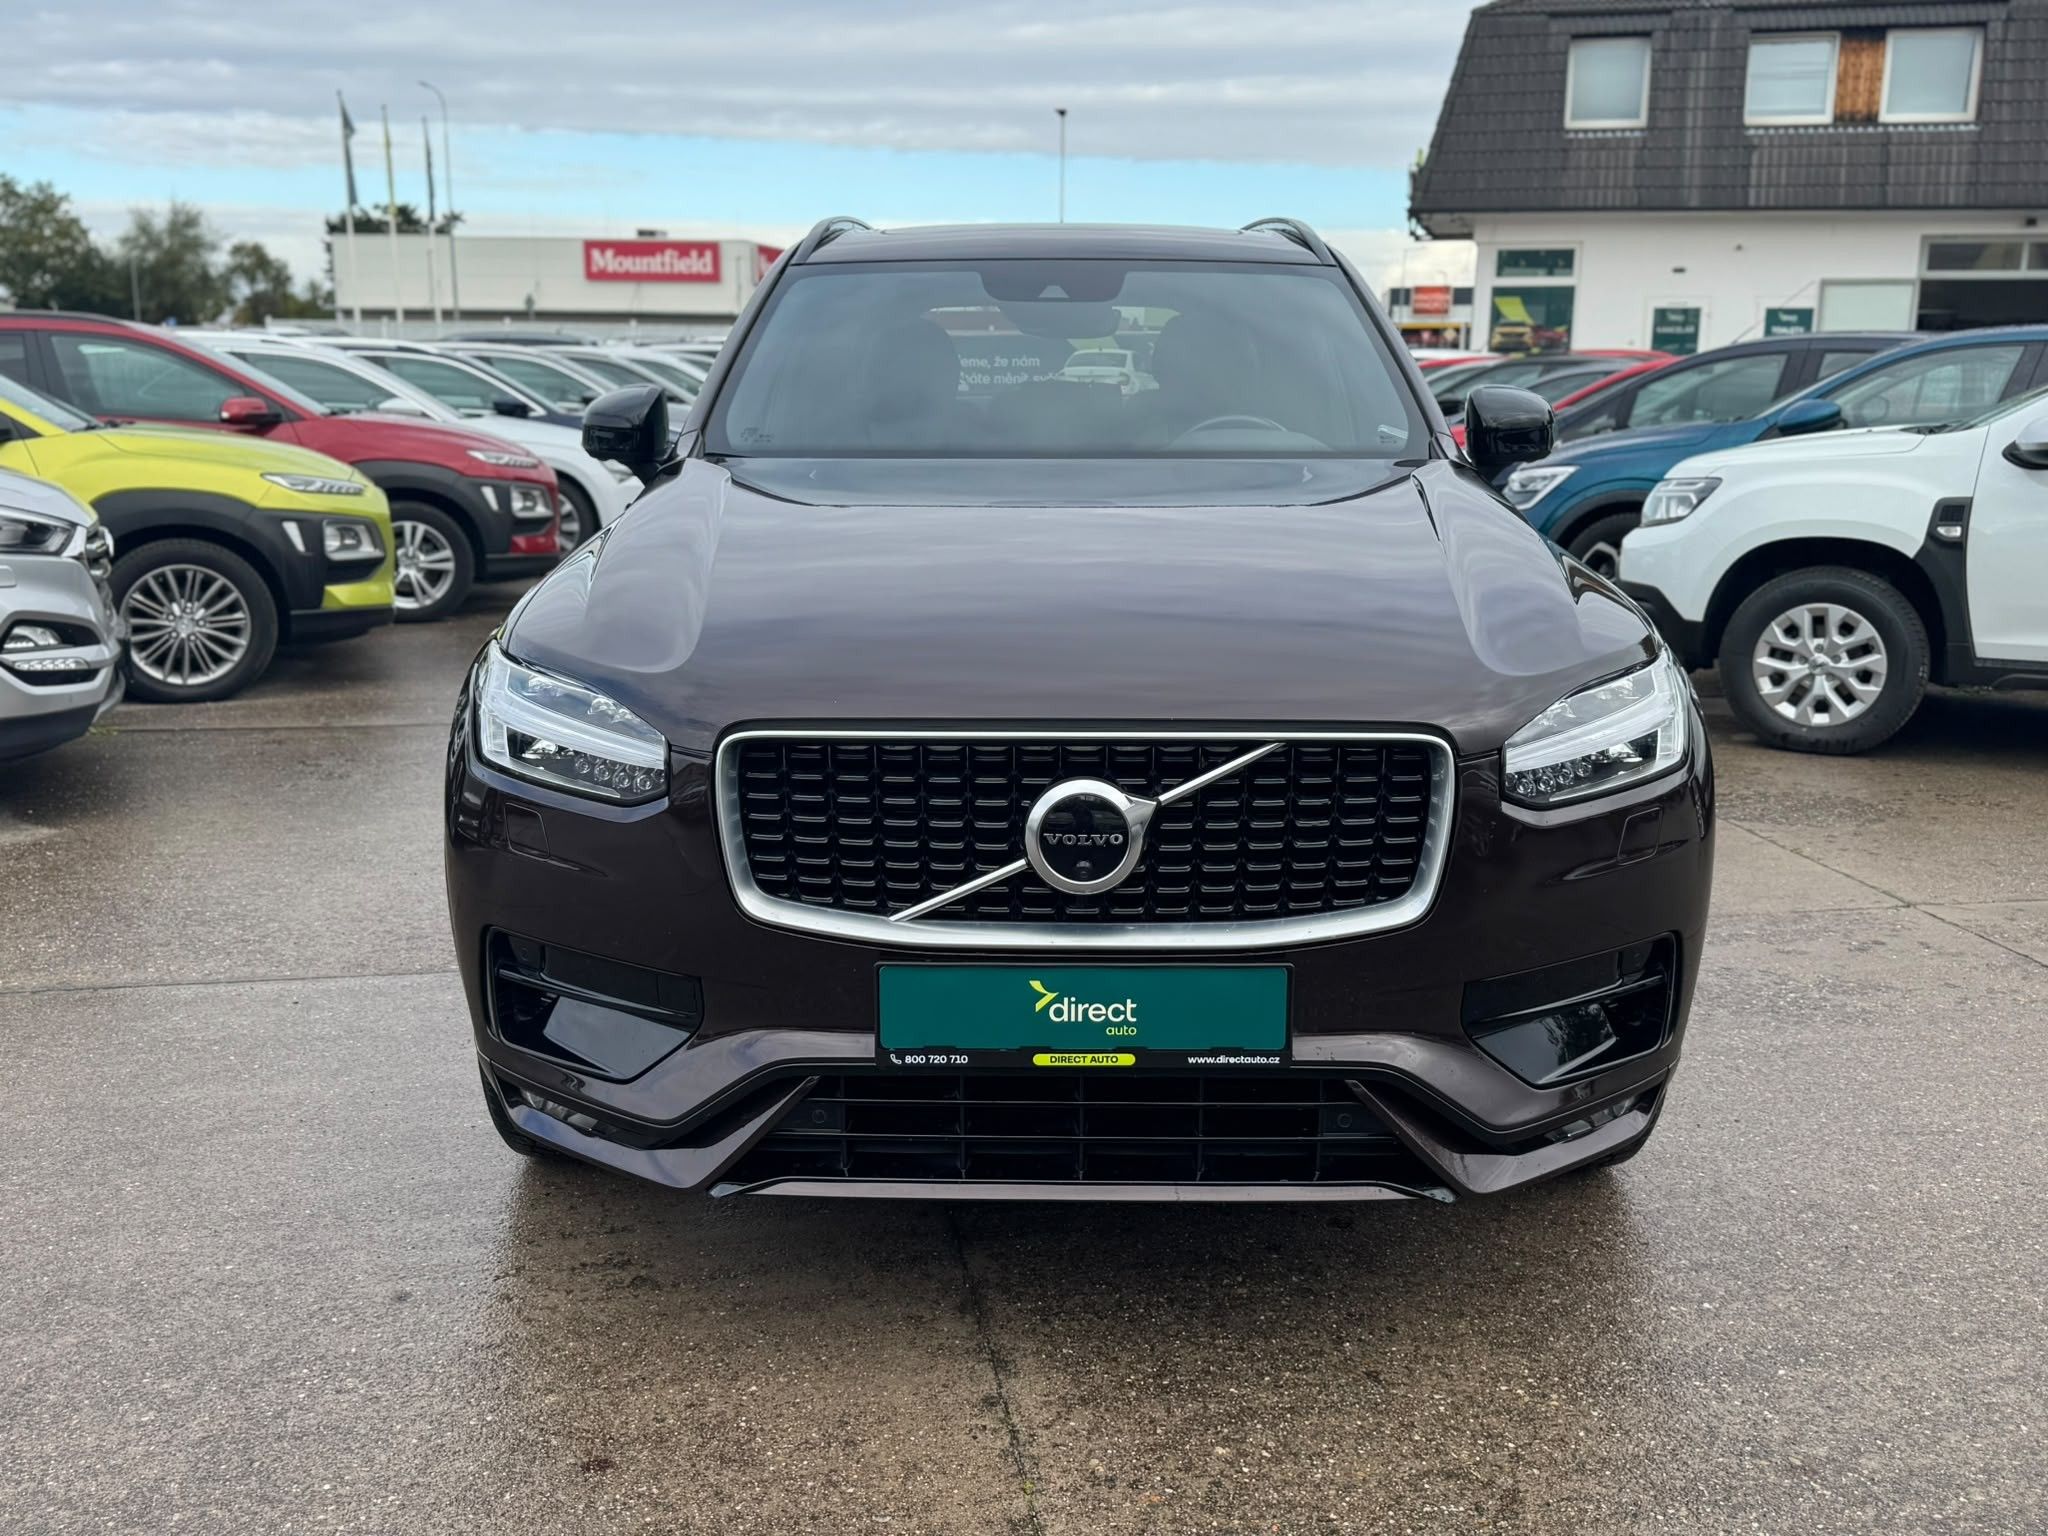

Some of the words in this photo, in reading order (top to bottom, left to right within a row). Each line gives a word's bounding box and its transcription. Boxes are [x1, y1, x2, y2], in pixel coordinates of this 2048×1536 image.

[591, 249, 714, 275] Mountfield
[958, 354, 991, 369] eme,
[1044, 833, 1124, 846] VOLVO
[1048, 997, 1137, 1023] direct
[1105, 1025, 1137, 1036] auto
[905, 1054, 926, 1064] 800
[928, 1054, 947, 1064] 720
[949, 1054, 968, 1064] 710
[1050, 1055, 1088, 1064] DIRECT
[1090, 1055, 1119, 1064] AUTO
[1188, 1054, 1280, 1065] www.directauto.cz
